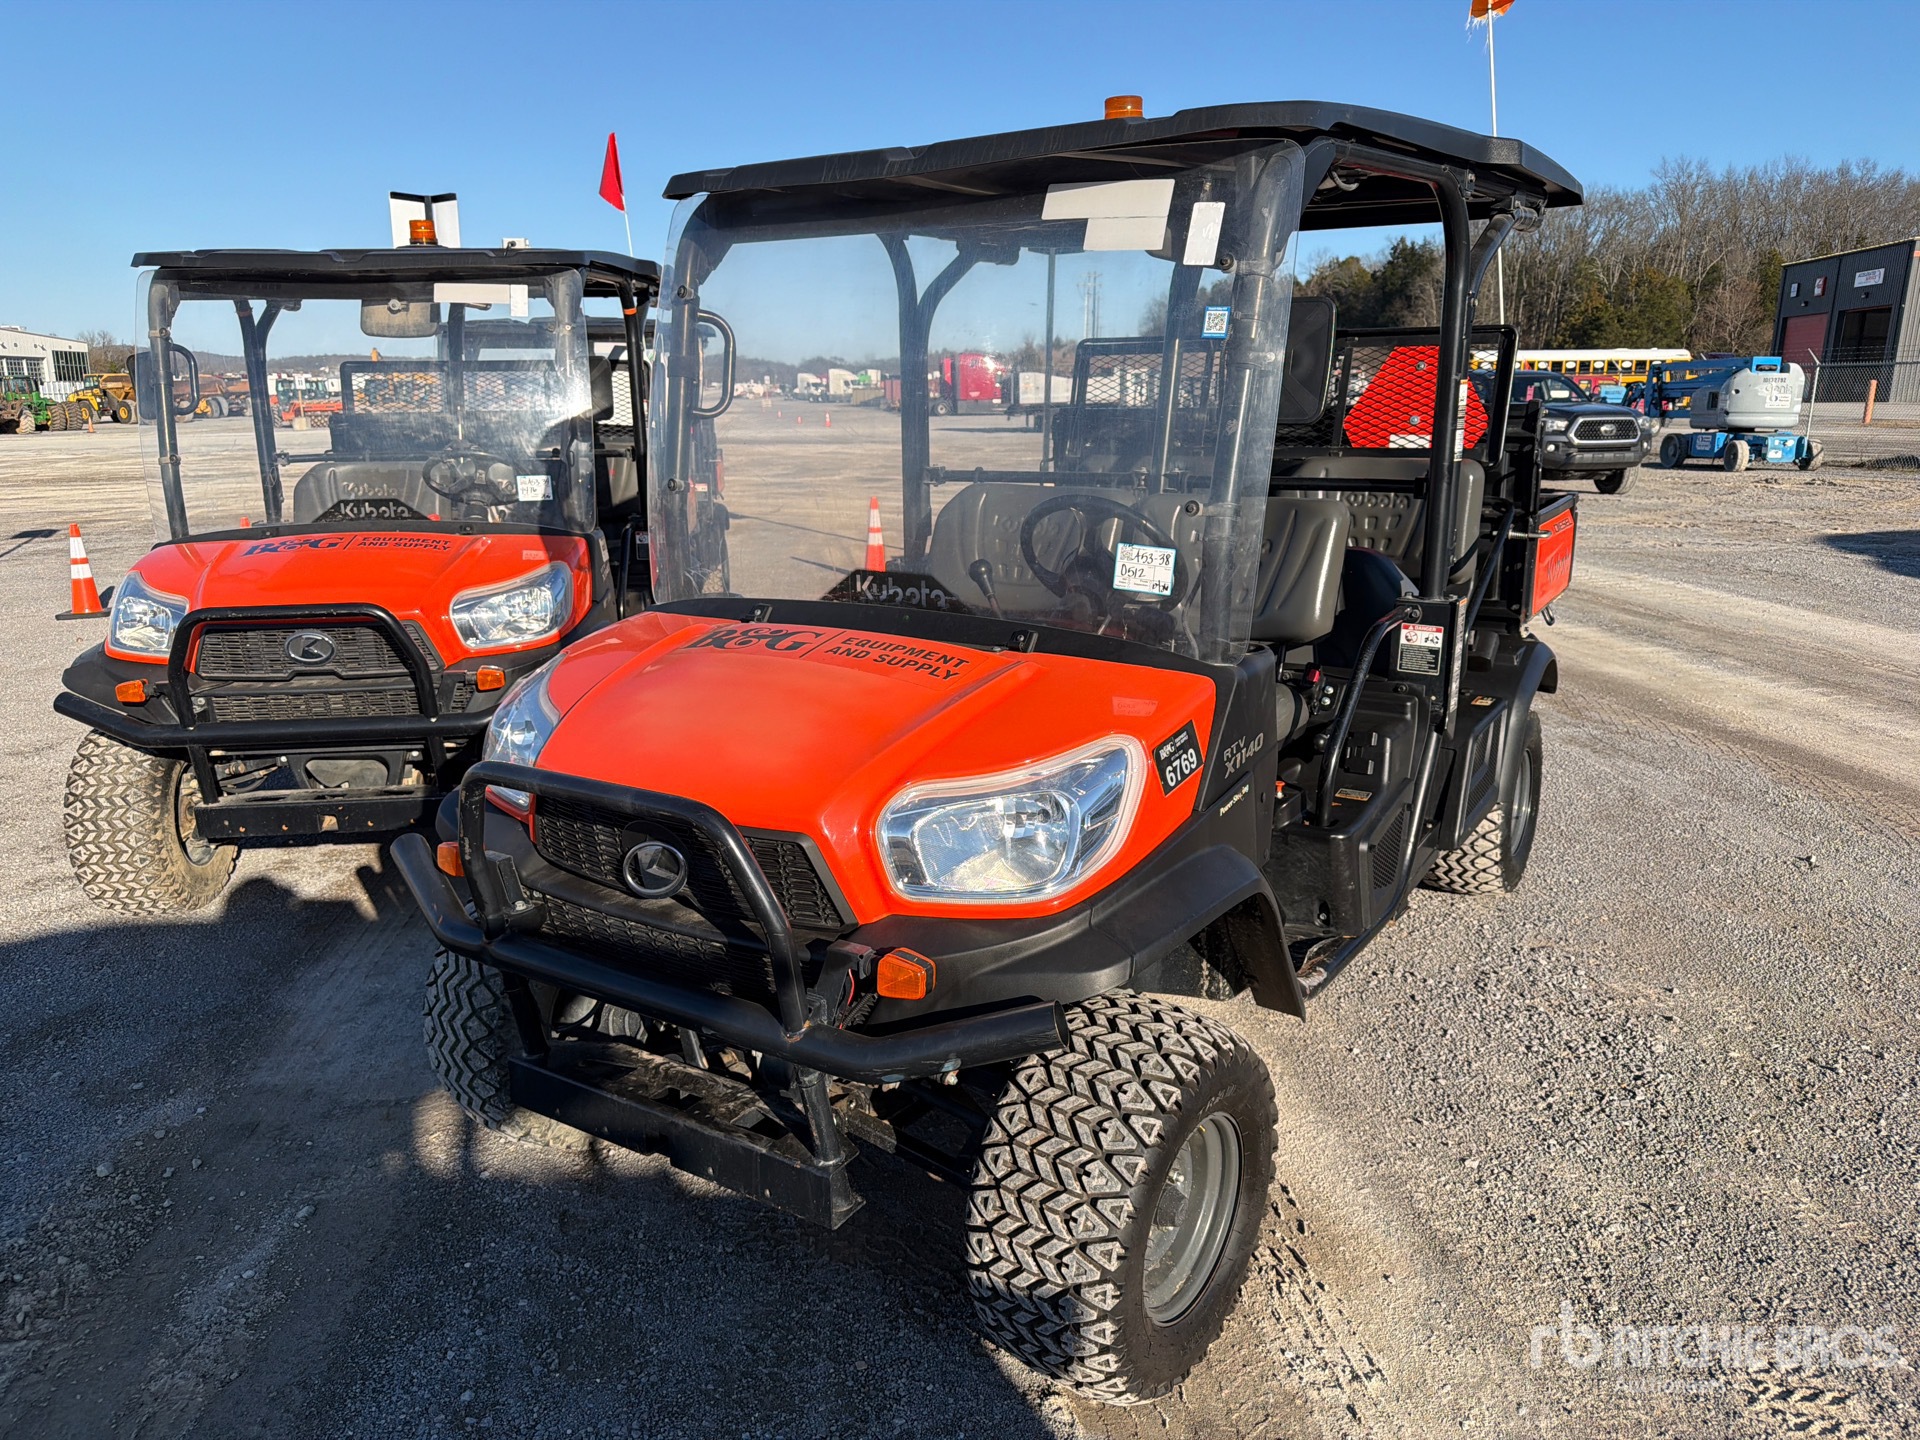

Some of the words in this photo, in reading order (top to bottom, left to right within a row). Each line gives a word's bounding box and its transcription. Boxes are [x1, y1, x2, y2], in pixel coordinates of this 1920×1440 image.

[340, 501, 411, 518] Kubota
[361, 536, 451, 546] EQUIPMENT
[393, 542, 452, 551] SUPPLY
[855, 574, 947, 608] Kubota
[685, 627, 826, 651] B&G
[841, 636, 970, 669] EQUIPMENT
[825, 645, 871, 660] AND
[872, 655, 962, 682] SUPPLY
[1223, 735, 1246, 762] RTV
[1224, 732, 1265, 779] X1140
[1165, 747, 1198, 787] 6769
